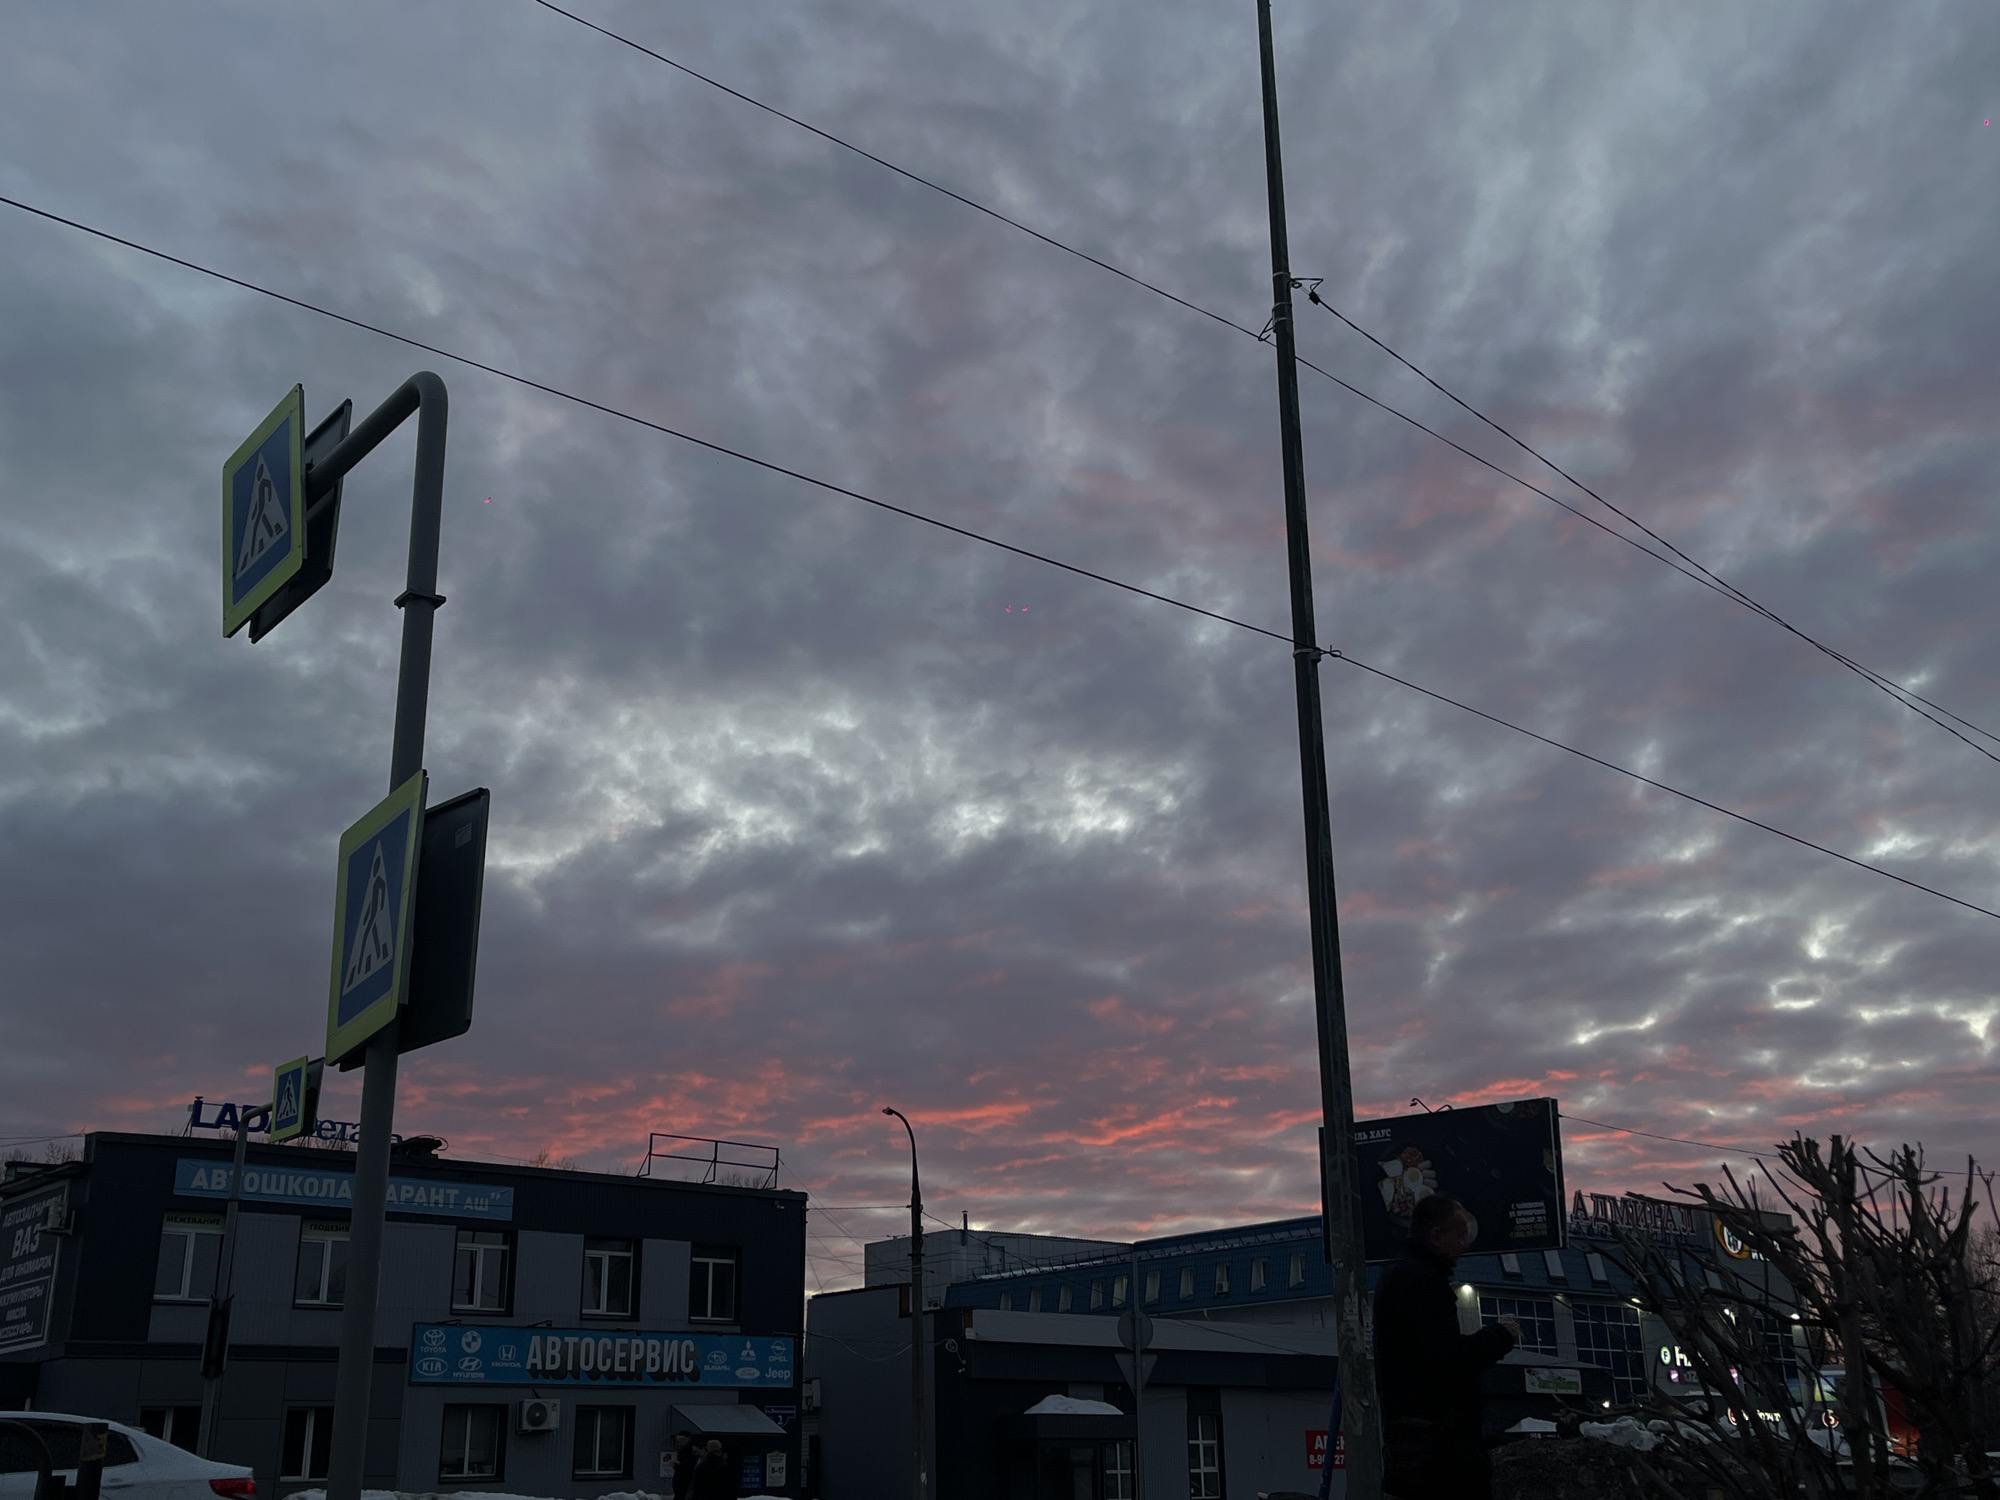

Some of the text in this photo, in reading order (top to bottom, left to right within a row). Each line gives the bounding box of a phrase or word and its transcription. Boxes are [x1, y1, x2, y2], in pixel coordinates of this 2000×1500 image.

[1369, 1128, 1392, 1139] ХАУС
[386, 1183, 460, 1208] АРАНТ
[166, 1215, 221, 1226] МЕЖЕВАНИЕ
[309, 1223, 350, 1233] ГЕОДЕЗИЯ
[11, 1222, 42, 1259] ВАЗ
[526, 1335, 695, 1373] АВТОСЕРВИС
[765, 1367, 791, 1380] Jeep
